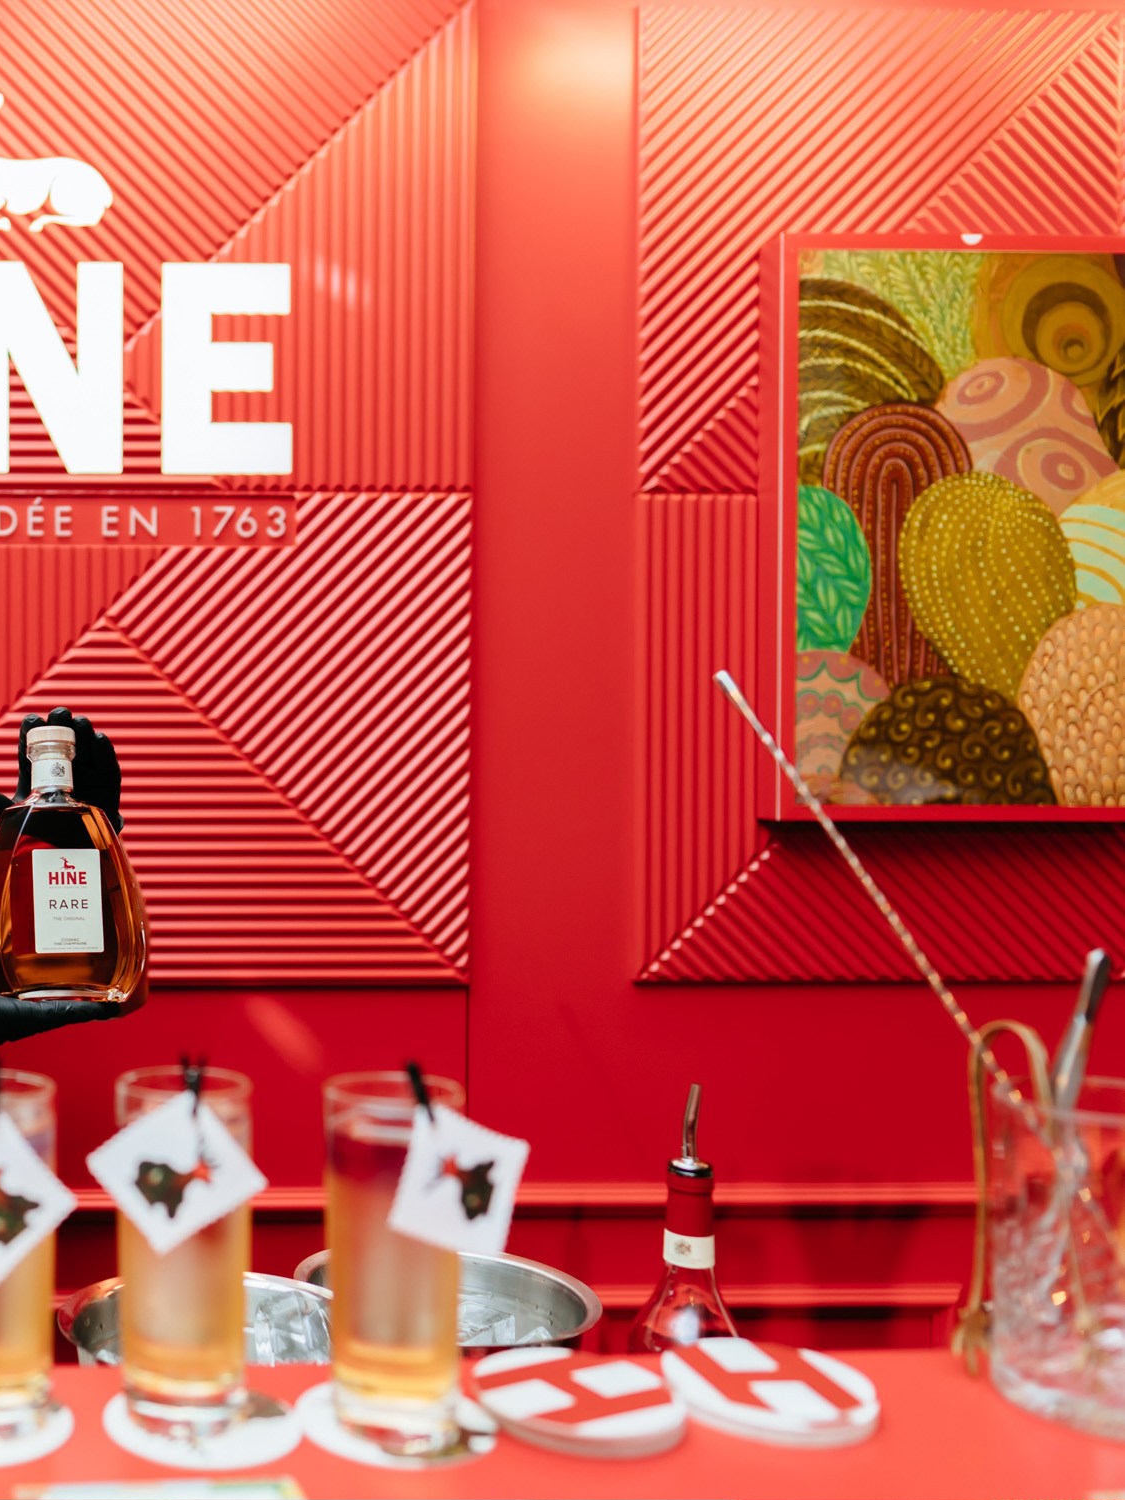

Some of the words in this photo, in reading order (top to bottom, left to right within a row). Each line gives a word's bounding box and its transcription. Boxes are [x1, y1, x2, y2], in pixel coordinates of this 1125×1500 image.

[101, 505, 159, 537] EN
[191, 505, 287, 538] 1763
[48, 871, 87, 885] HINE
[49, 899, 89, 910] RARE
